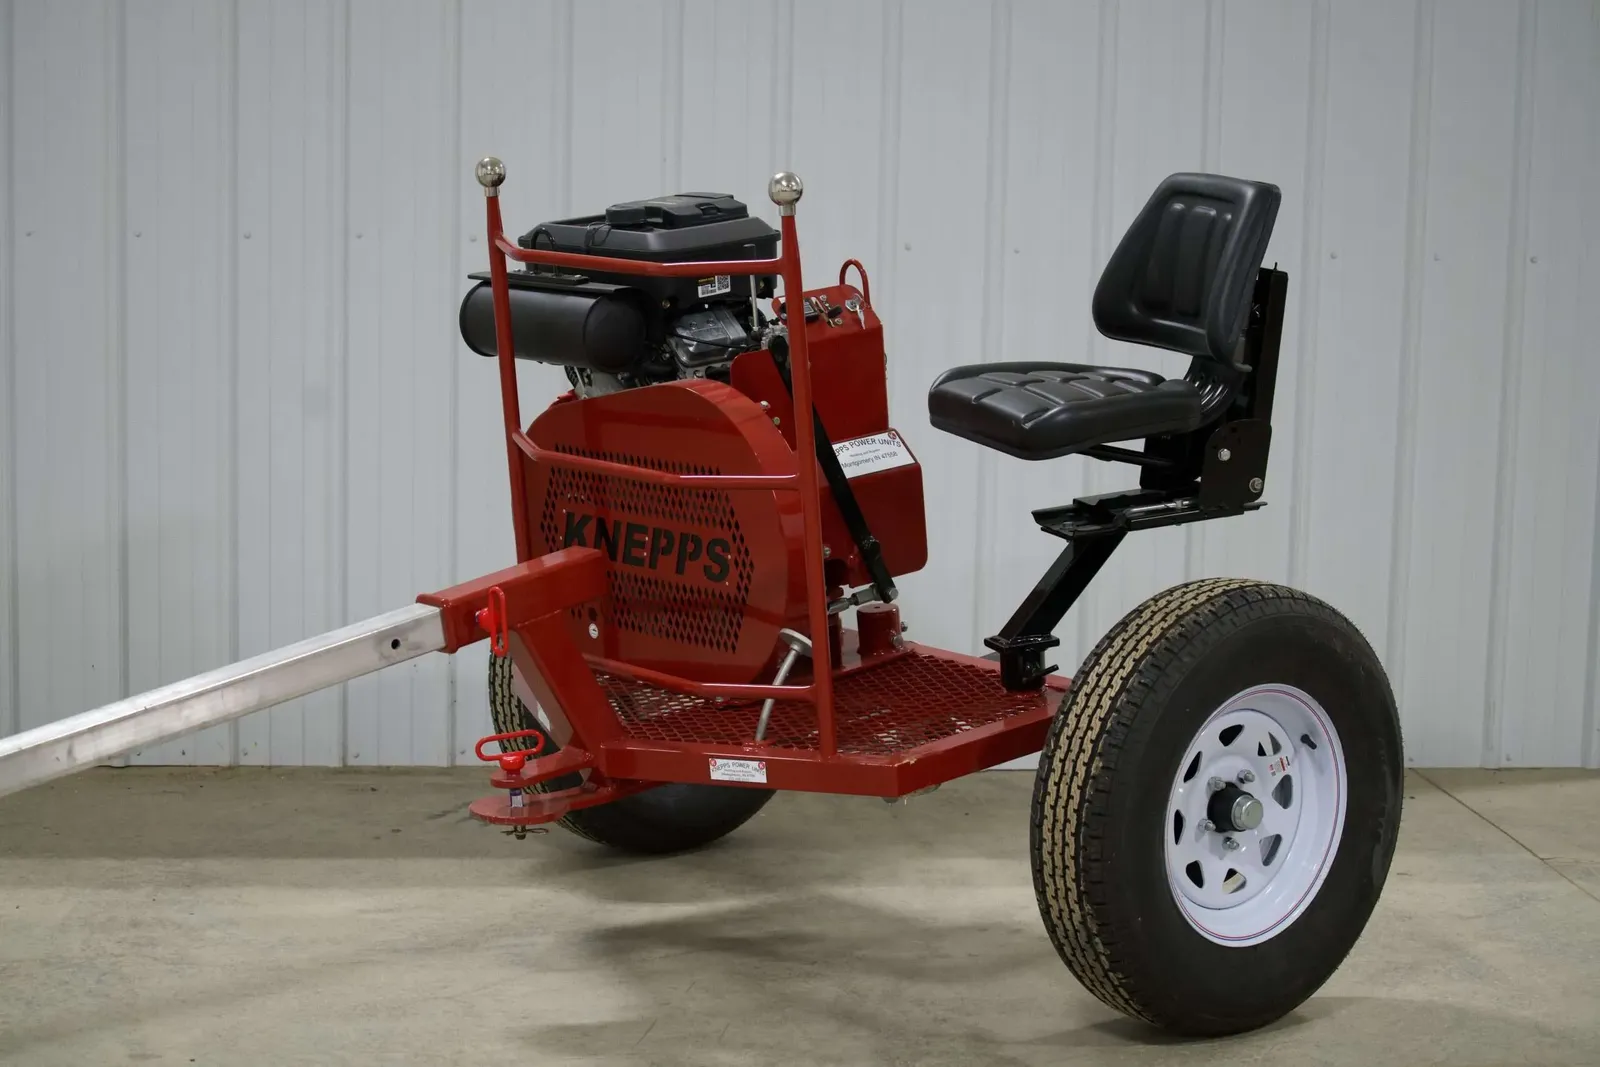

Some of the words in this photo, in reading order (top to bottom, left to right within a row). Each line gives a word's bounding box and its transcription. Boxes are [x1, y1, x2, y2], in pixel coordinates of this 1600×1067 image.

[849, 438, 877, 448] POWER
[877, 439, 901, 448] UNITS
[841, 457, 874, 468] Montgomery
[563, 511, 732, 583] KNEPPS
